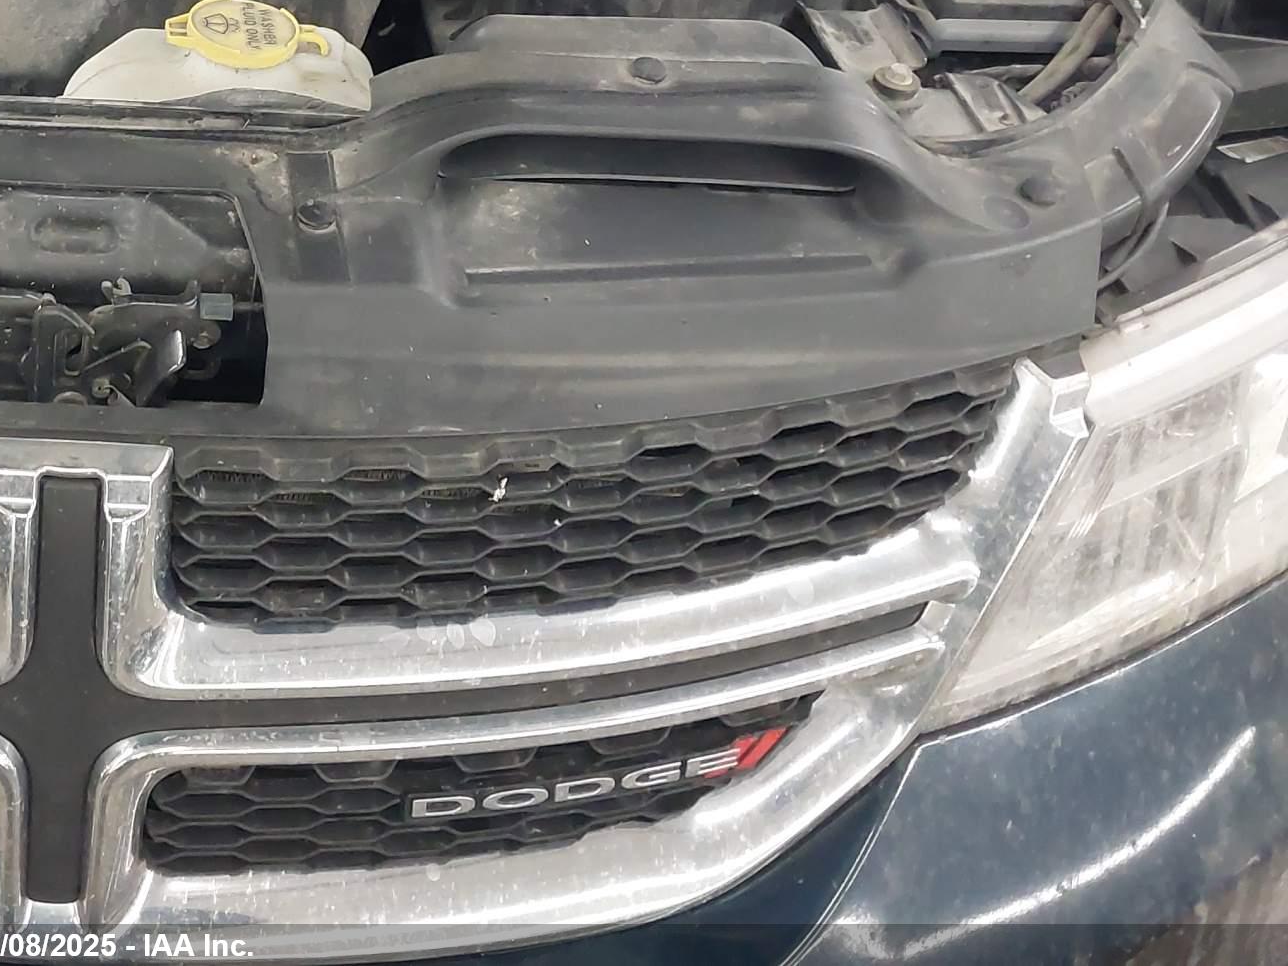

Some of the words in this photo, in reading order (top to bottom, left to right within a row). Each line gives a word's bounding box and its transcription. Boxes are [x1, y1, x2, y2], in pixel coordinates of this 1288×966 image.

[241, 2, 256, 26] FLUID
[258, 9, 277, 44] WASHER
[246, 29, 262, 50] ONLY
[411, 747, 740, 818] DODGE
